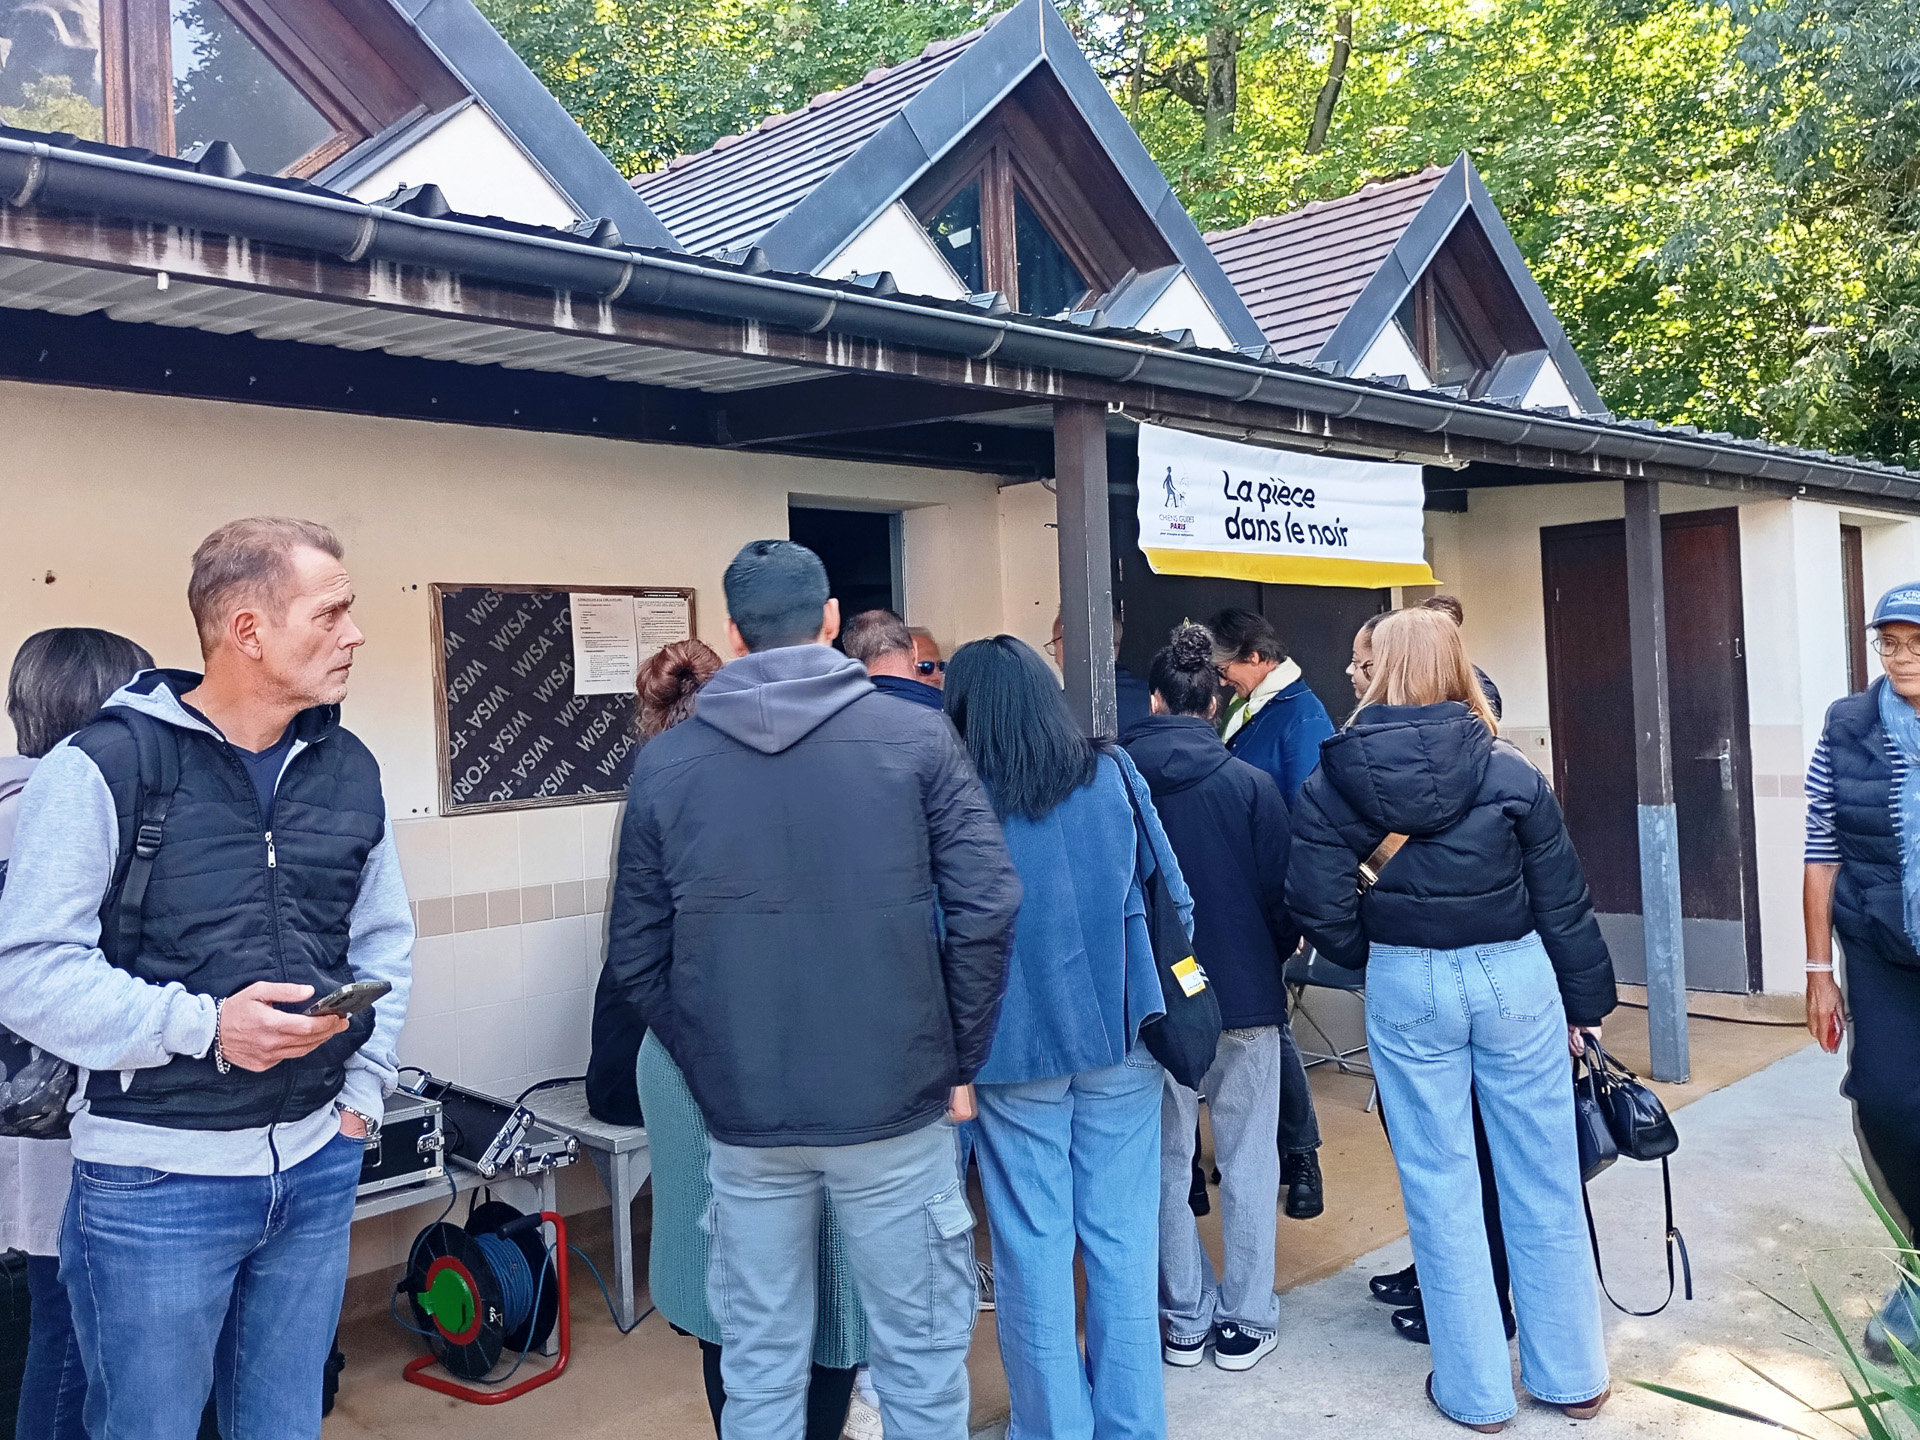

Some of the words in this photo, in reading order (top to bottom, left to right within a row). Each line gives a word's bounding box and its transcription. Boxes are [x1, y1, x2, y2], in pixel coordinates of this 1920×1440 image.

[1222, 470, 1253, 502] La
[1257, 476, 1315, 512] pièce
[1170, 522, 1186, 530] PARIS
[1225, 507, 1281, 543] dans
[1284, 511, 1305, 544] le
[1308, 517, 1348, 547] noir
